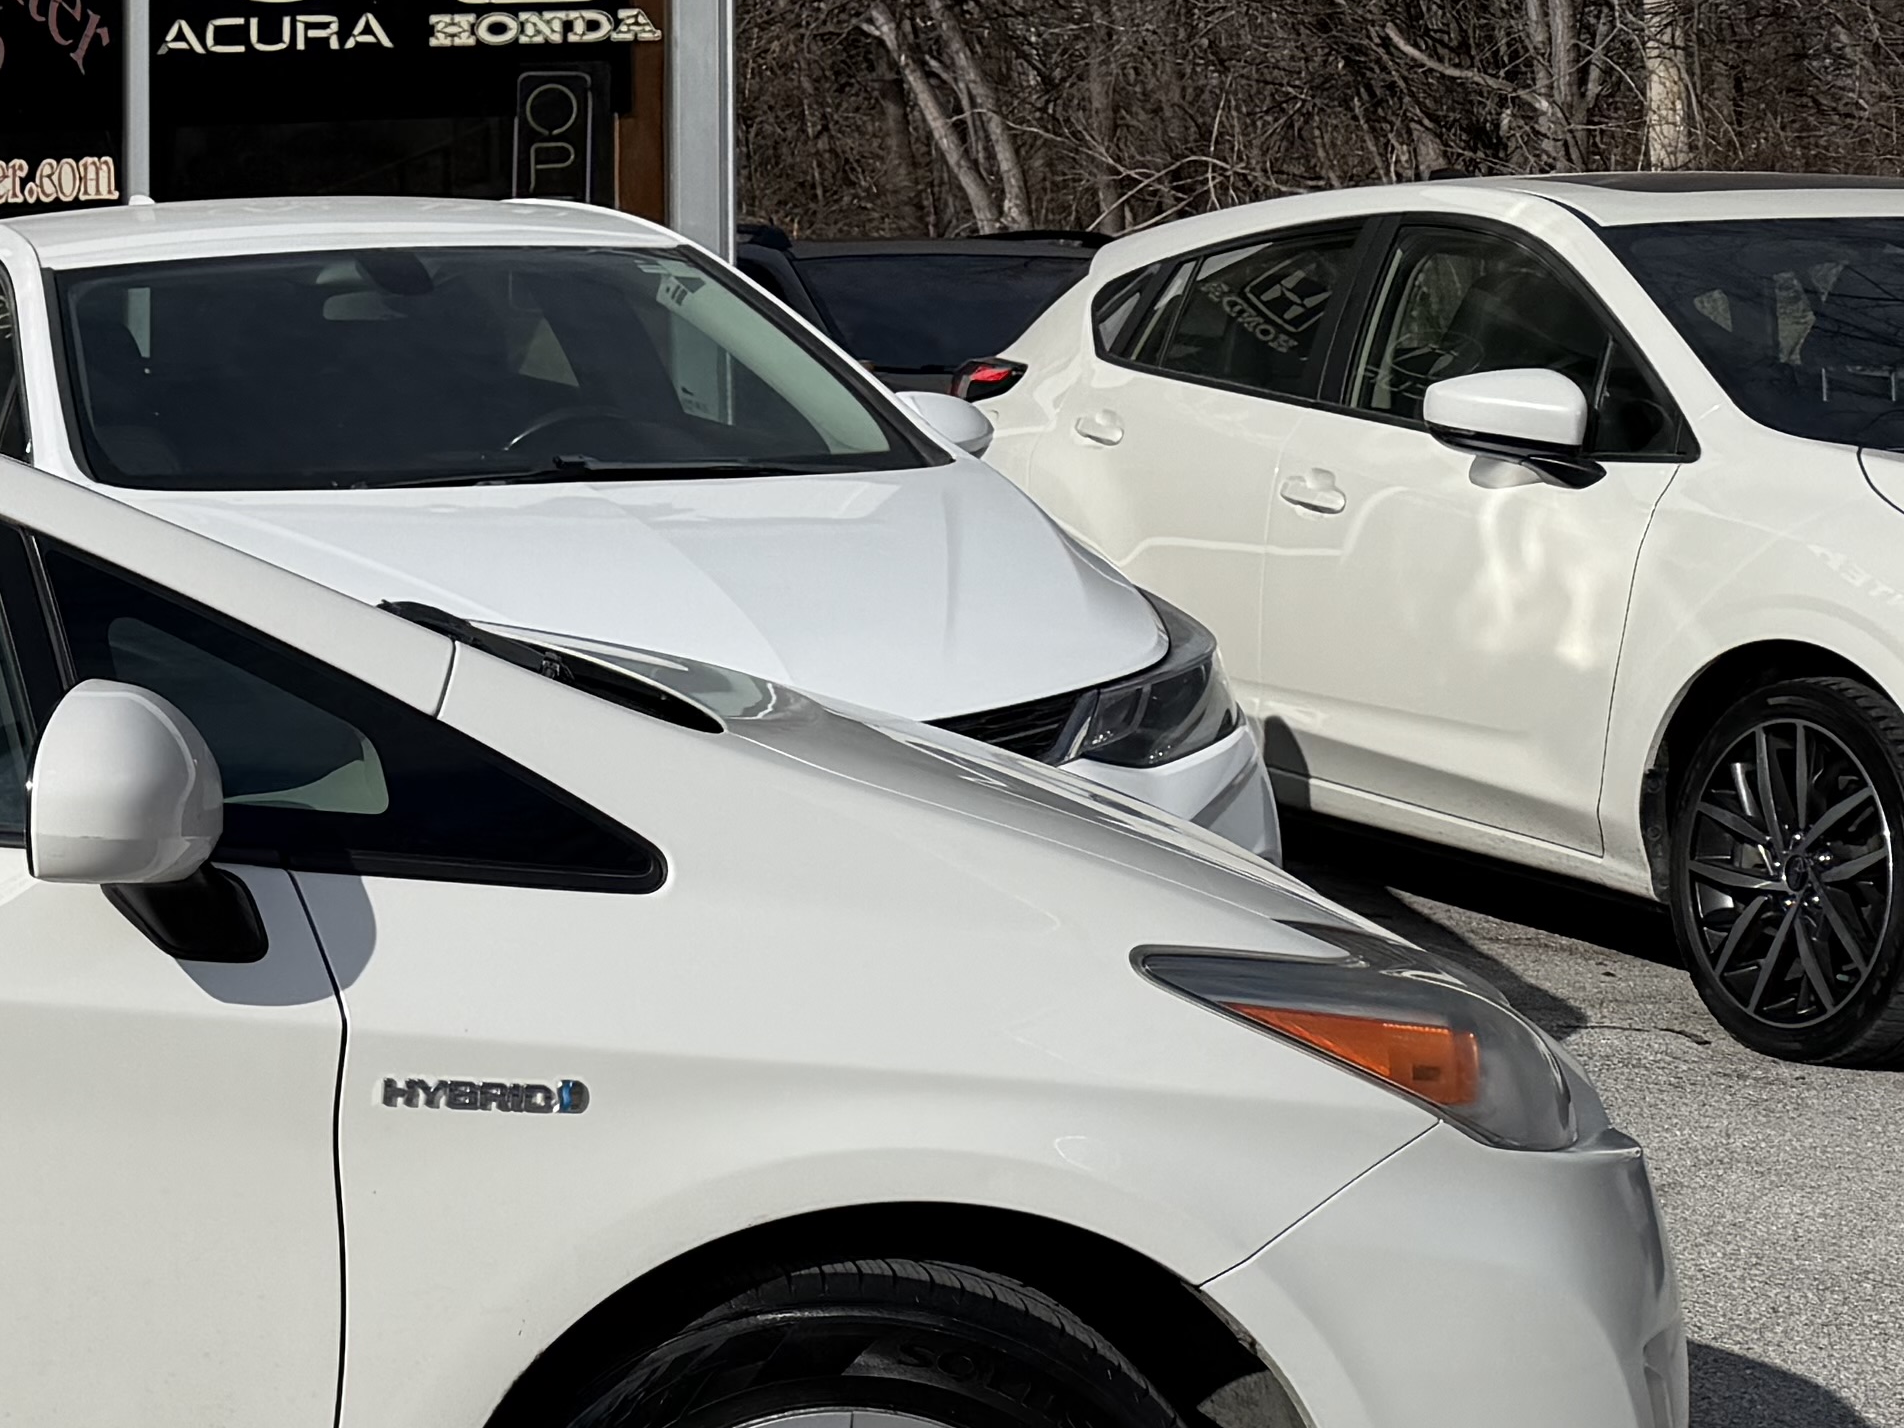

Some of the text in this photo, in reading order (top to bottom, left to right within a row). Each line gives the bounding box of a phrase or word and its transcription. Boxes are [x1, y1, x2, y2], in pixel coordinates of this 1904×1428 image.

[157, 12, 394, 55] ACURA
[428, 7, 663, 47] HONDA
[525, 83, 579, 195] OP
[381, 1076, 557, 1115] HYBRID
